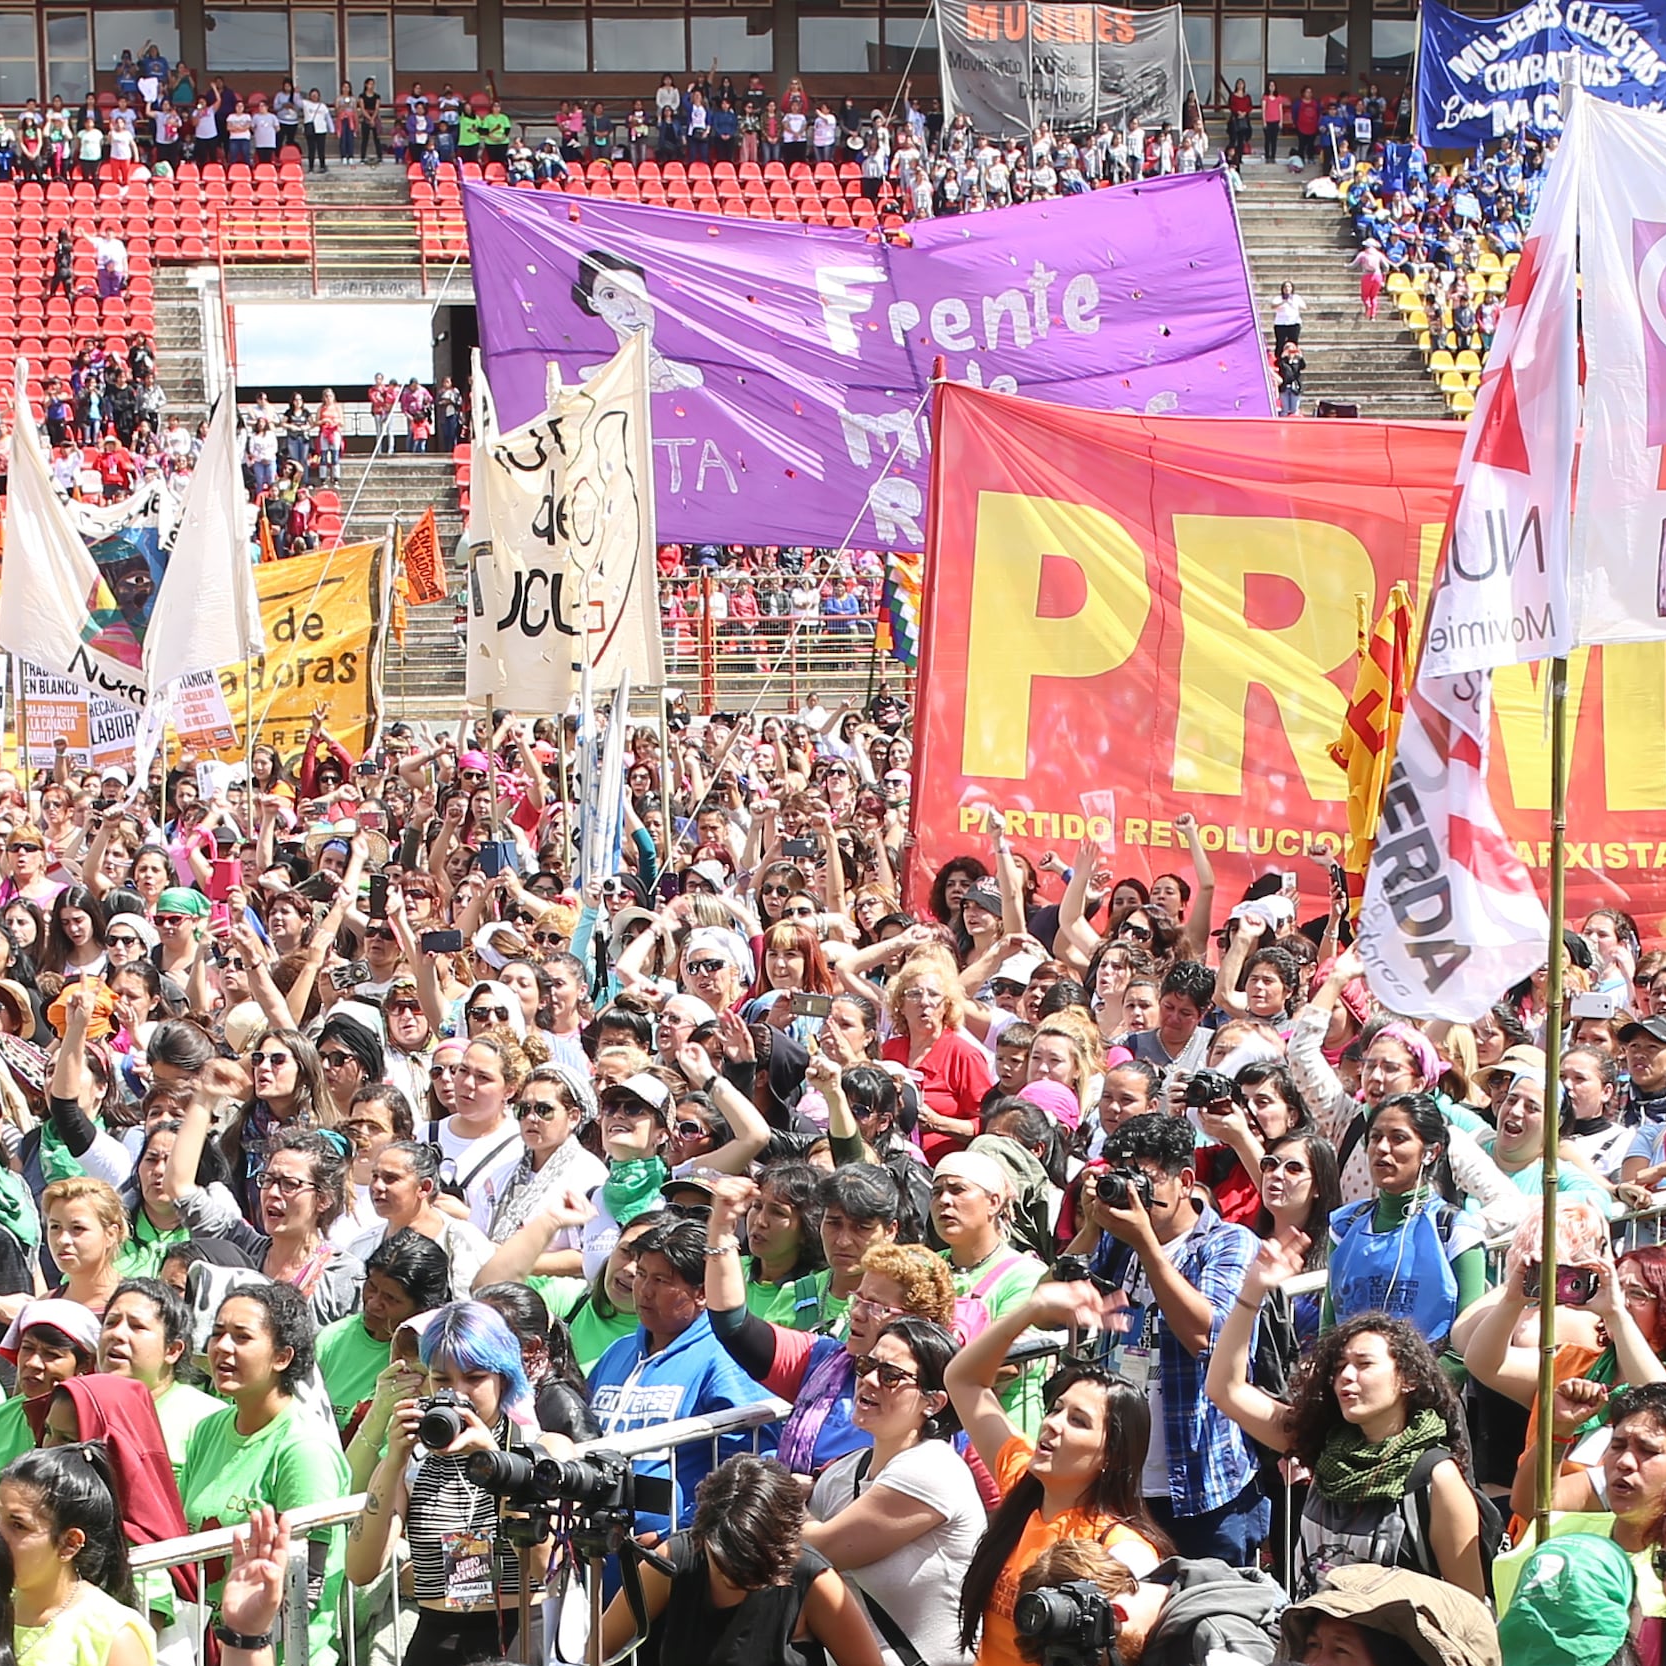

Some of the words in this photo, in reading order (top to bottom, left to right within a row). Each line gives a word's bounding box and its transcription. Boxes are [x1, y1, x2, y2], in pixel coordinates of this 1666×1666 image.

[966, 3, 1137, 44] MUJERES
[1447, 0, 1564, 84] MUJERES
[814, 259, 1101, 359] Frente
[272, 607, 324, 642] de
[24, 679, 36, 695] EN
[39, 679, 79, 696] BLANCO
[218, 651, 358, 697] adoras
